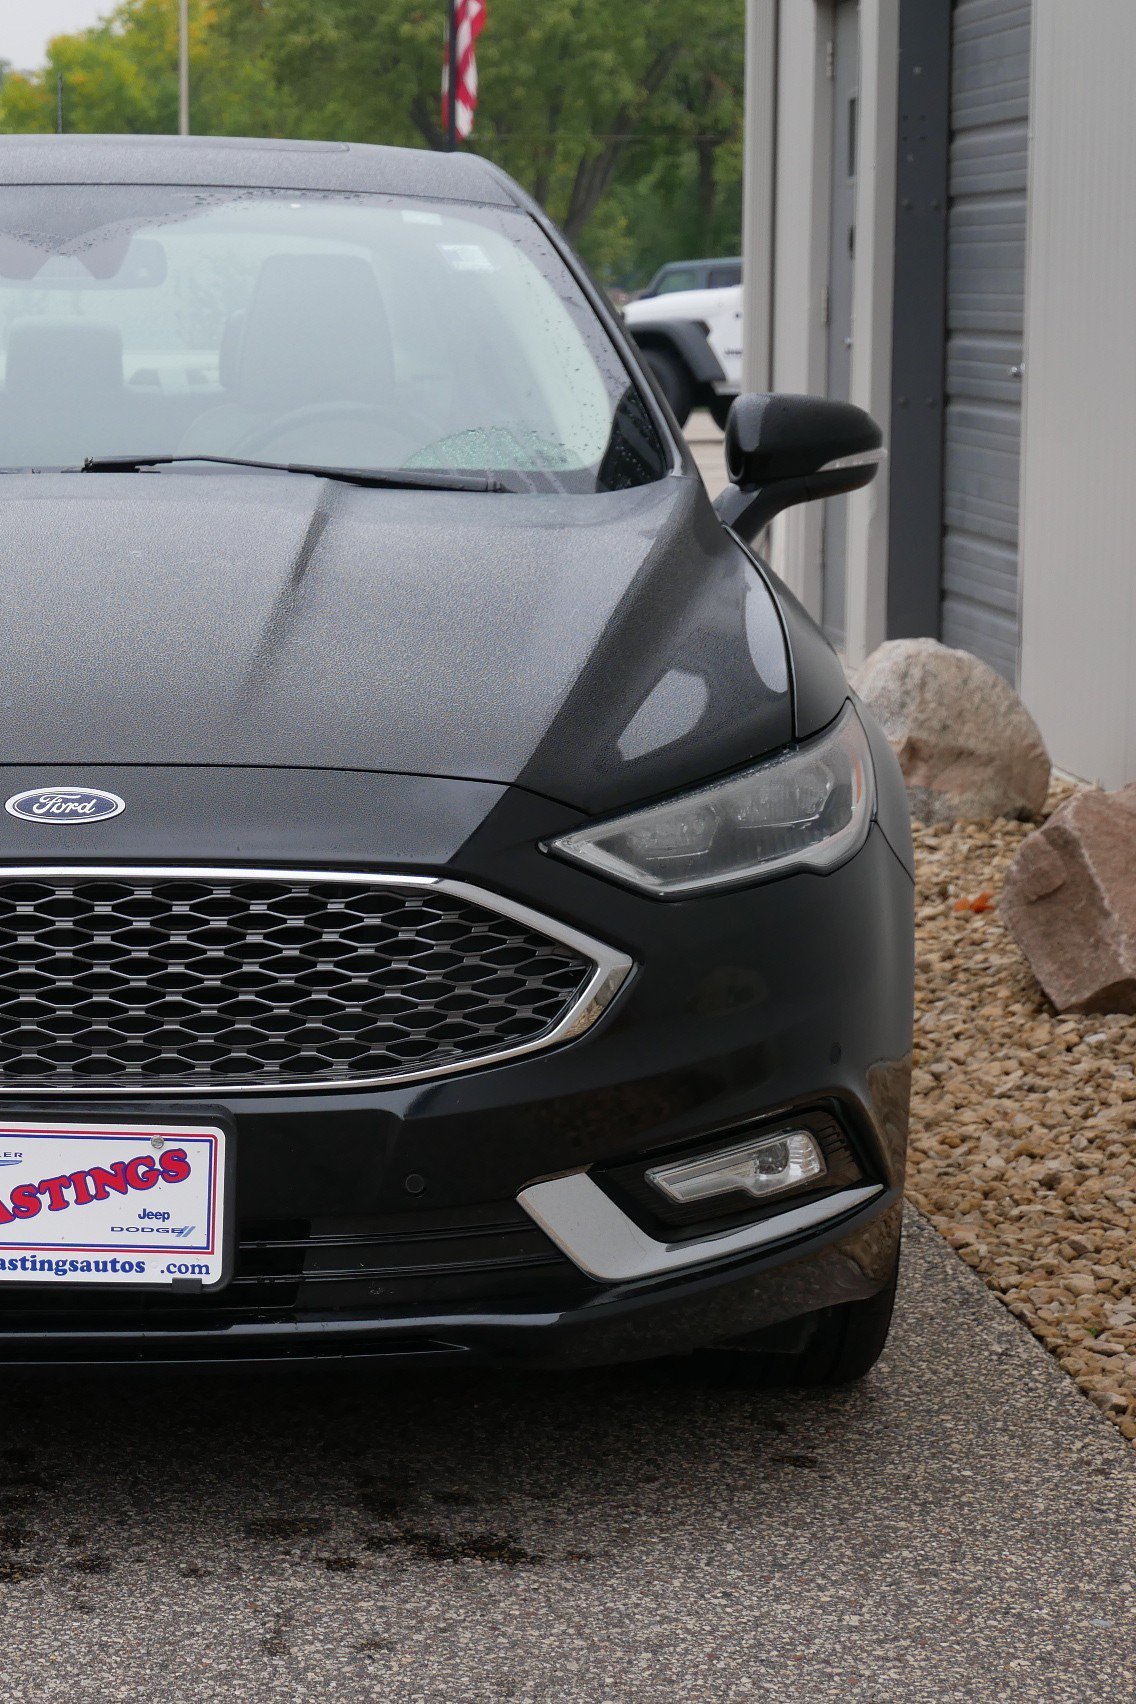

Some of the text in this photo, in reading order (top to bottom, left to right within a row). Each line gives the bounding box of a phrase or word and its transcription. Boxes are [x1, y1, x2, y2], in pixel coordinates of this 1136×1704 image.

[32, 794, 97, 814] Ford
[137, 1208, 170, 1223] Jeep
[110, 1226, 184, 1235] DODGE
[160, 1260, 211, 1276] .com
